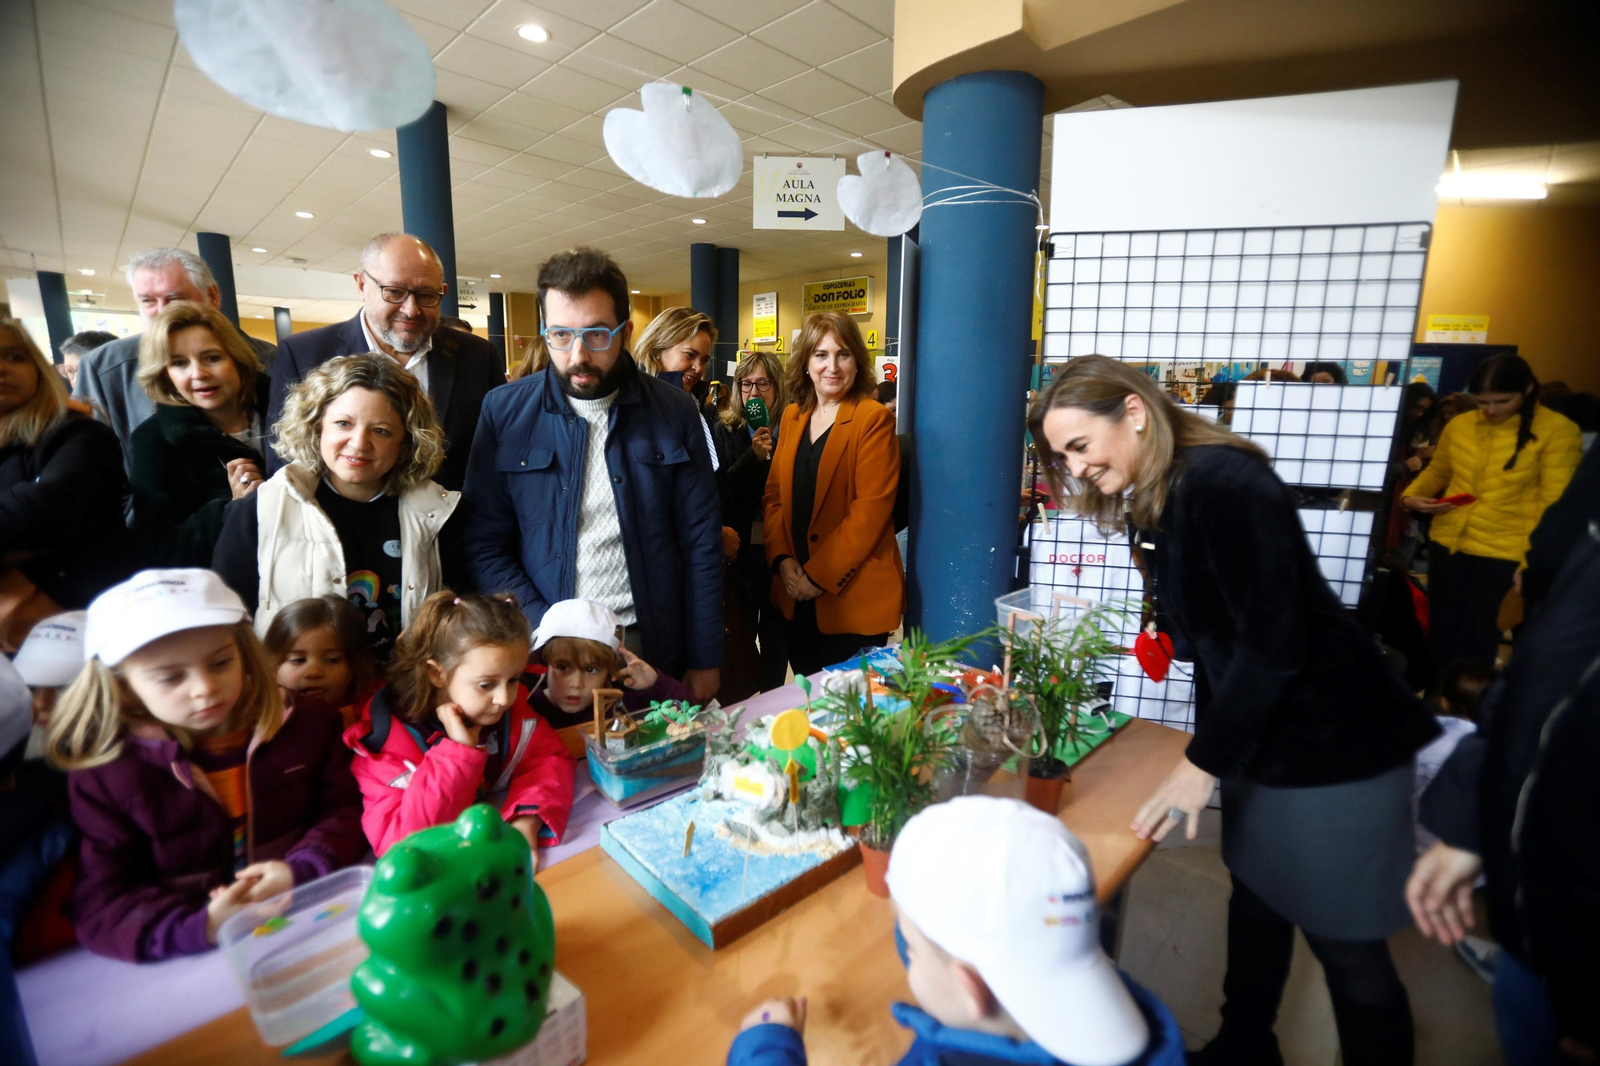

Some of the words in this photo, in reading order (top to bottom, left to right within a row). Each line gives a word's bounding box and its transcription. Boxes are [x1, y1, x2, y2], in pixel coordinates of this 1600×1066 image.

[783, 180, 815, 189] AULA
[776, 193, 821, 203] MAGNA
[814, 292, 835, 303] DON
[776, 338, 782, 351] 2
[868, 332, 875, 347] 4
[882, 363, 897, 383] 3
[1049, 554, 1106, 564] DOCTOR
